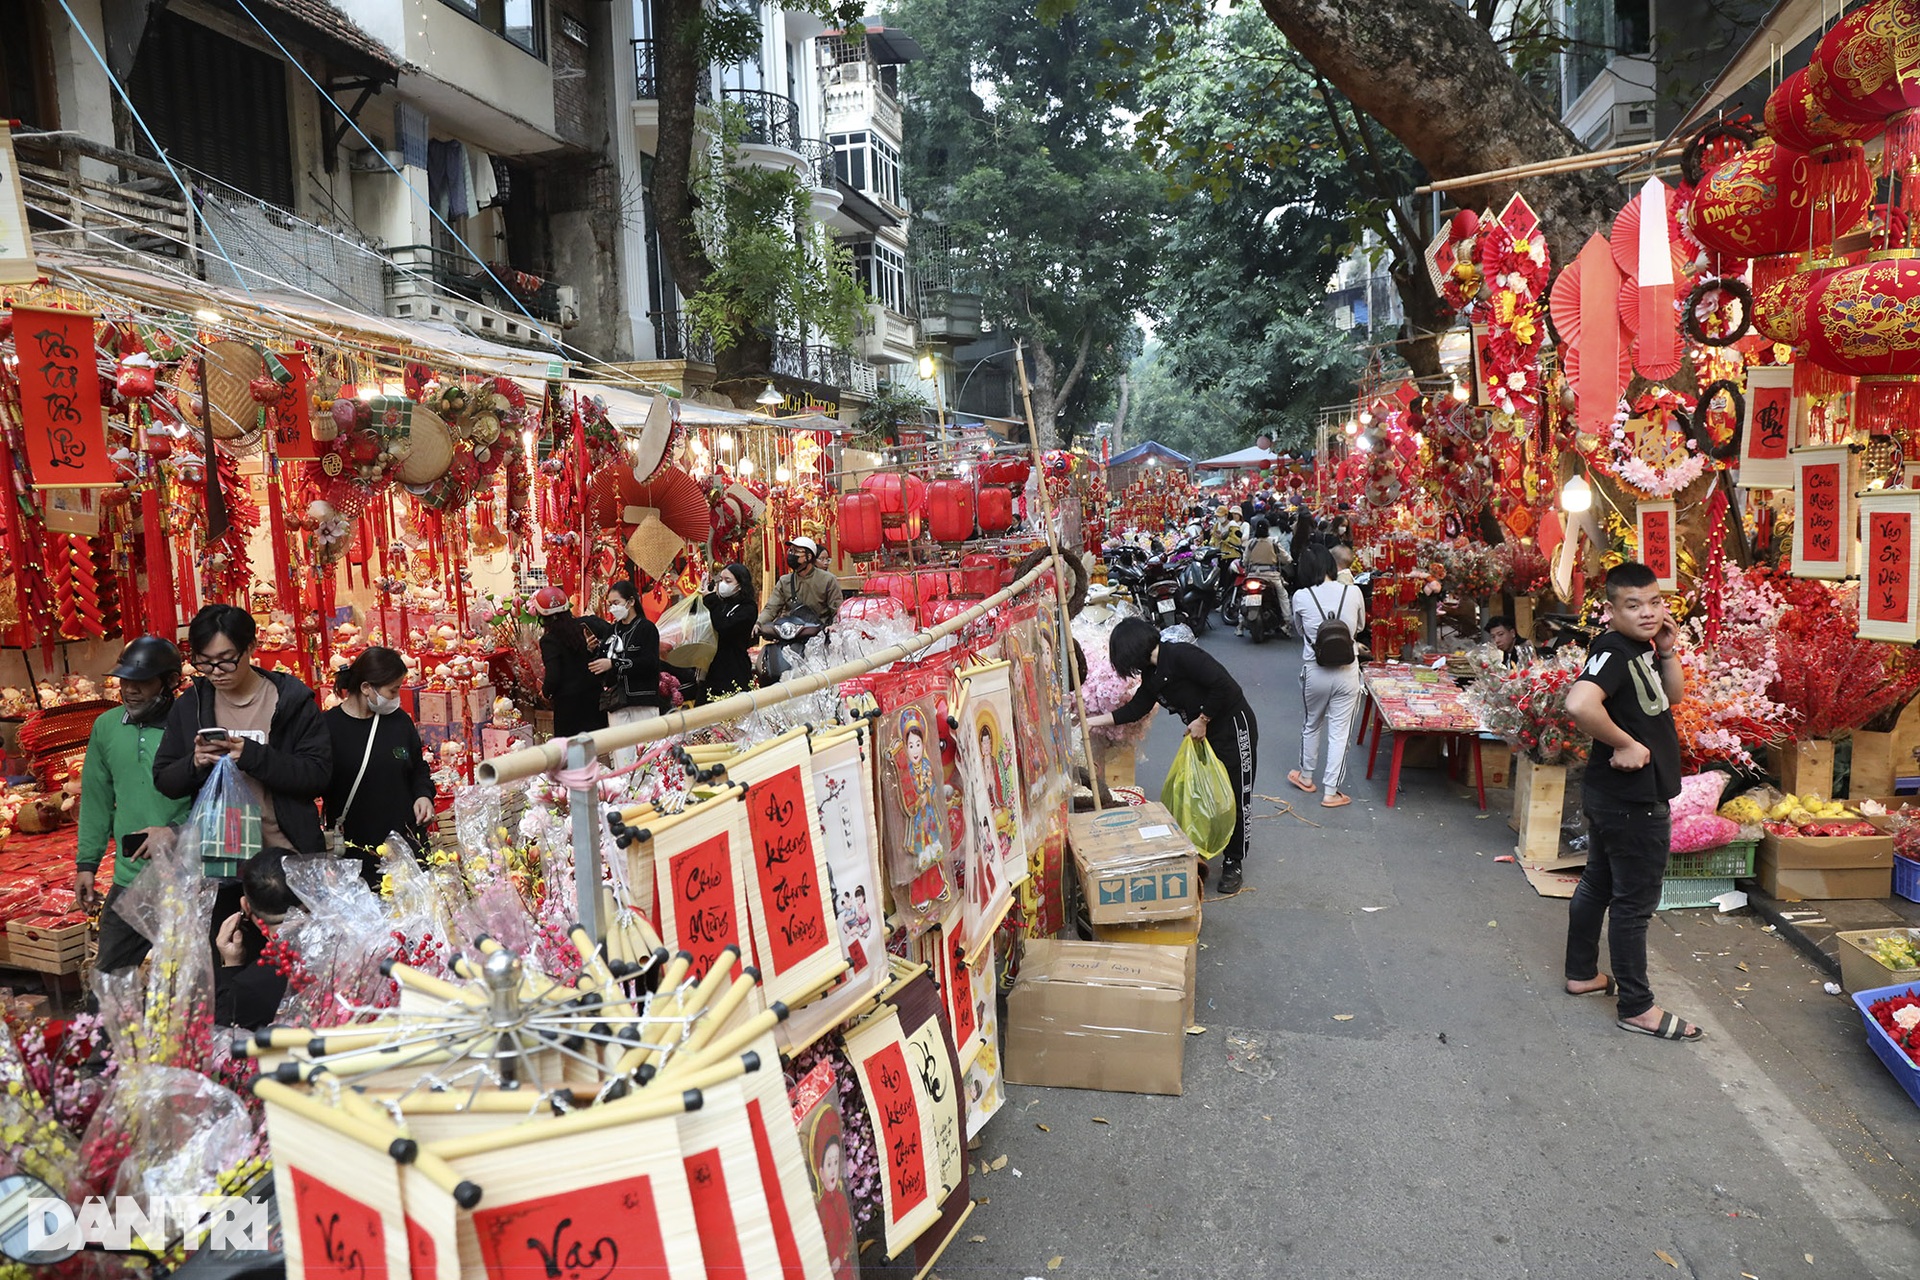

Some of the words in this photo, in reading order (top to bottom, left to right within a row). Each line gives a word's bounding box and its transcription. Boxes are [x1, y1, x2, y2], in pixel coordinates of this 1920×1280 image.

[1880, 521, 1902, 542] Vạn
[765, 792, 794, 828] An
[765, 831, 807, 875] Khang
[686, 862, 722, 901] Chúc
[772, 872, 811, 912] Thịnh
[689, 905, 729, 944] Mừng
[781, 913, 817, 948] Vượng
[881, 1063, 901, 1094] An
[884, 1098, 914, 1135] Khang
[894, 1132, 918, 1168] Thịnh
[898, 1168, 921, 1198] Vượng
[527, 1218, 618, 1280] Vạn
